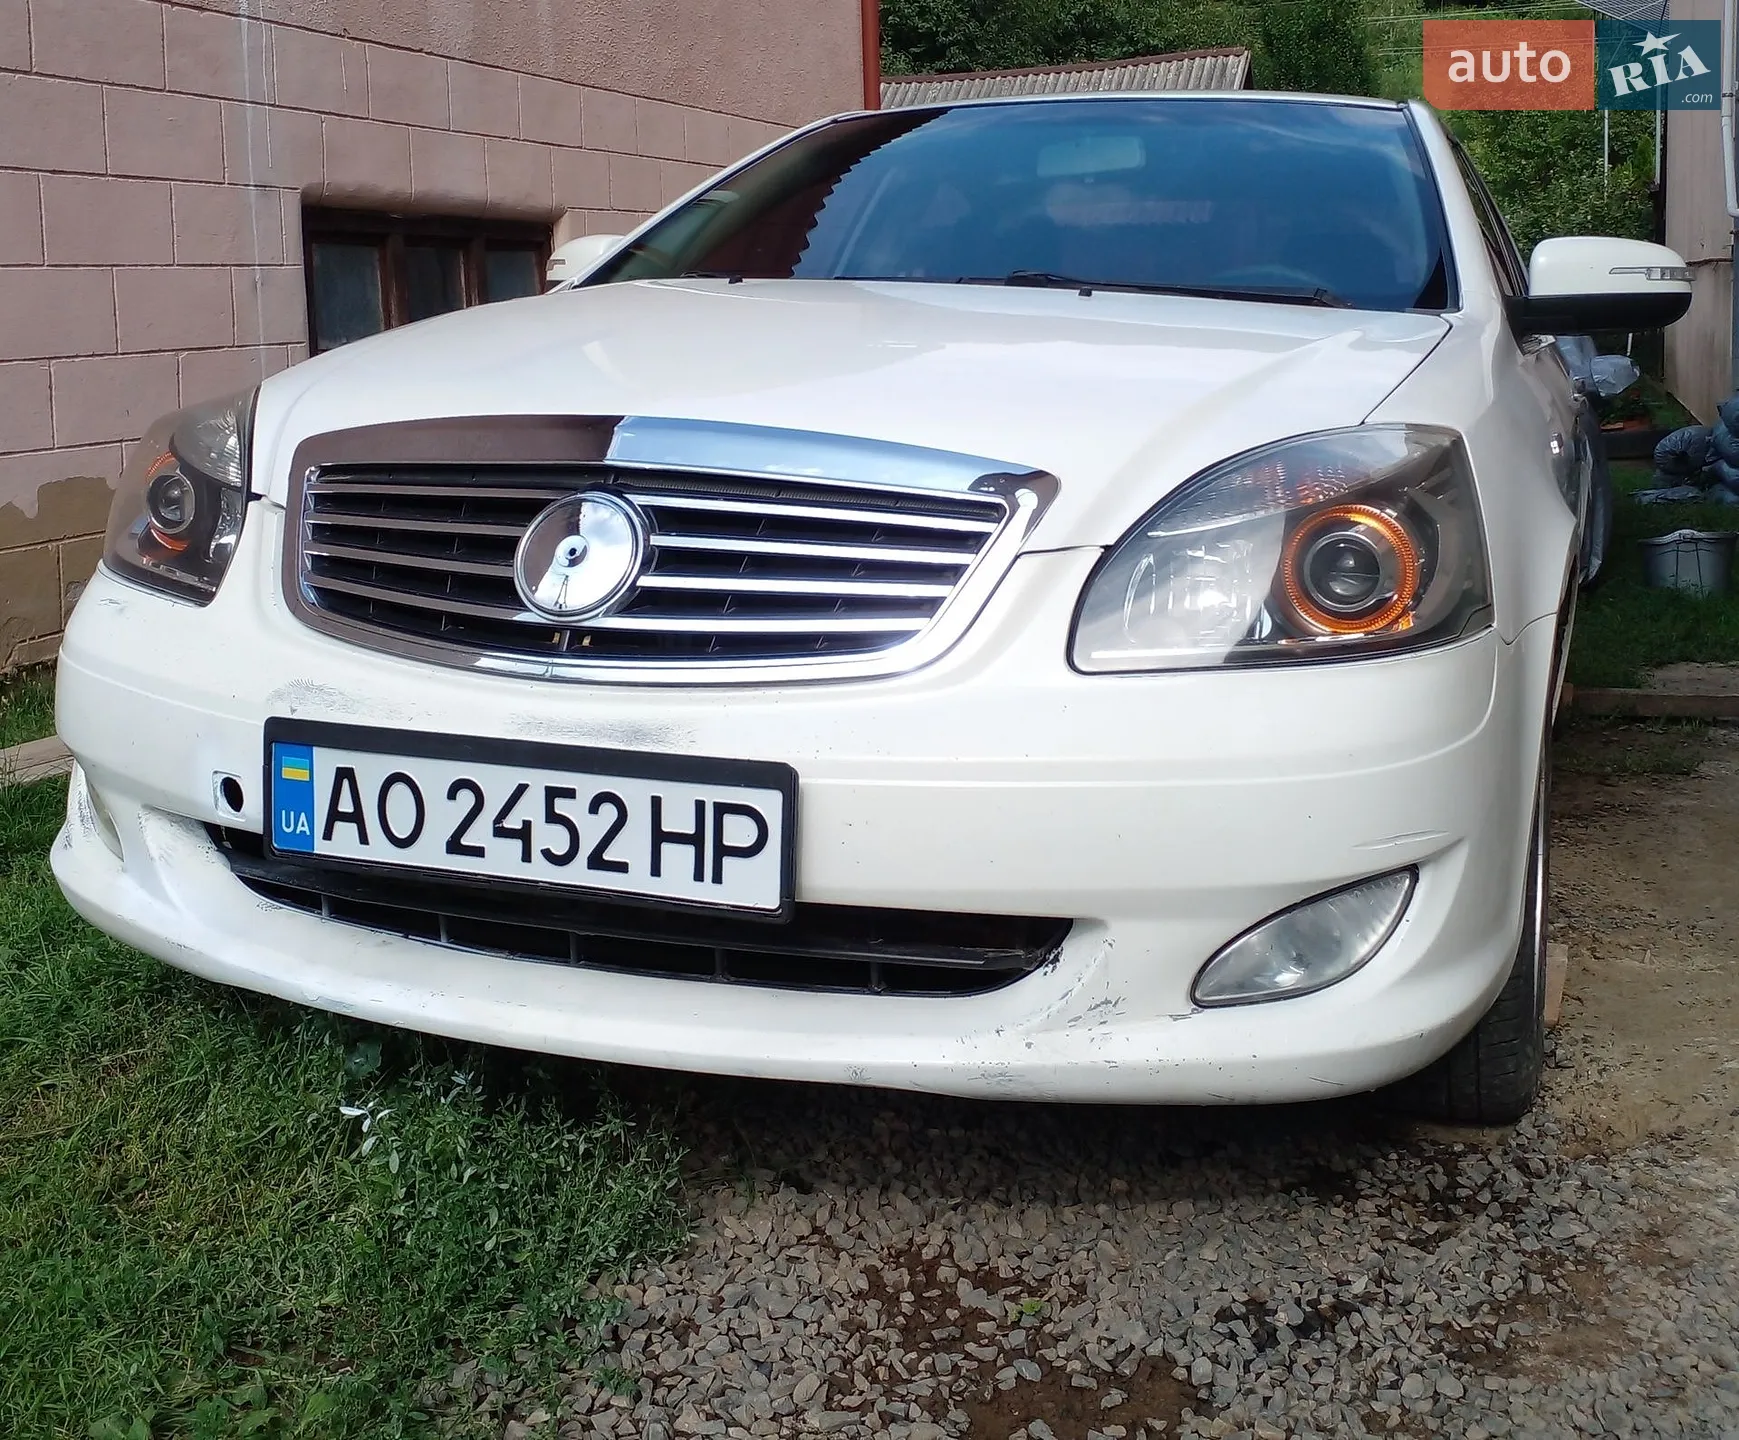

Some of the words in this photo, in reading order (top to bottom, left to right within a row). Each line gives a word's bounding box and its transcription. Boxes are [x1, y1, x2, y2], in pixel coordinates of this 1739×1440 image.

[281, 810, 310, 836] UA
[322, 765, 426, 849] AO
[445, 777, 629, 874] 2452
[650, 794, 769, 885] HP
